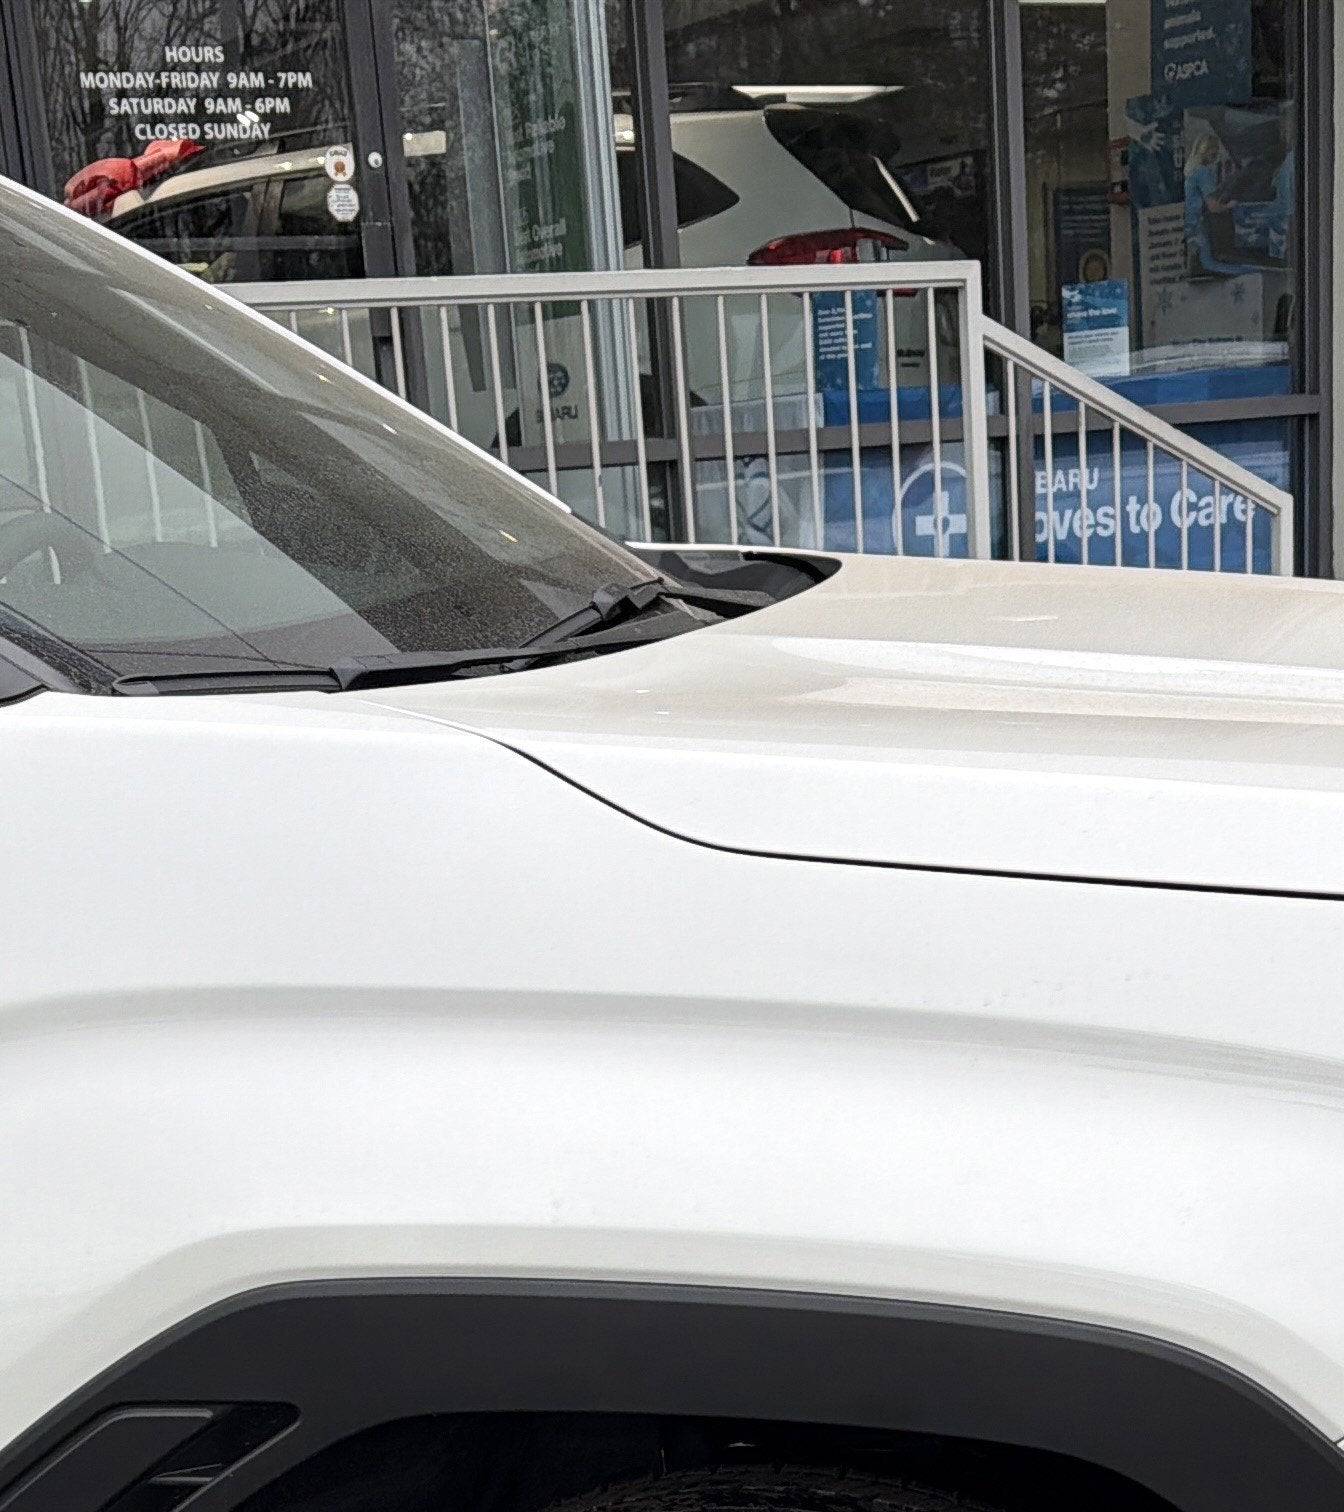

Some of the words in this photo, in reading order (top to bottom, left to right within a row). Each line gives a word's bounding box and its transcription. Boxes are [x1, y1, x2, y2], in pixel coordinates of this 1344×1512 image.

[164, 46, 225, 63] HOURS
[79, 71, 220, 89] MONDAY-FRIDAY
[226, 71, 265, 88] 9AM
[276, 71, 313, 88] 7PM
[108, 97, 197, 115] SATURDAY
[204, 97, 242, 114] 9AM
[254, 97, 291, 114] 6PM
[134, 122, 200, 140] CLOSED
[204, 122, 271, 140] SUNDAY
[1035, 467, 1099, 494] BARU
[1035, 504, 1116, 542] oves
[1126, 495, 1163, 533] to
[1170, 488, 1256, 529] Care
